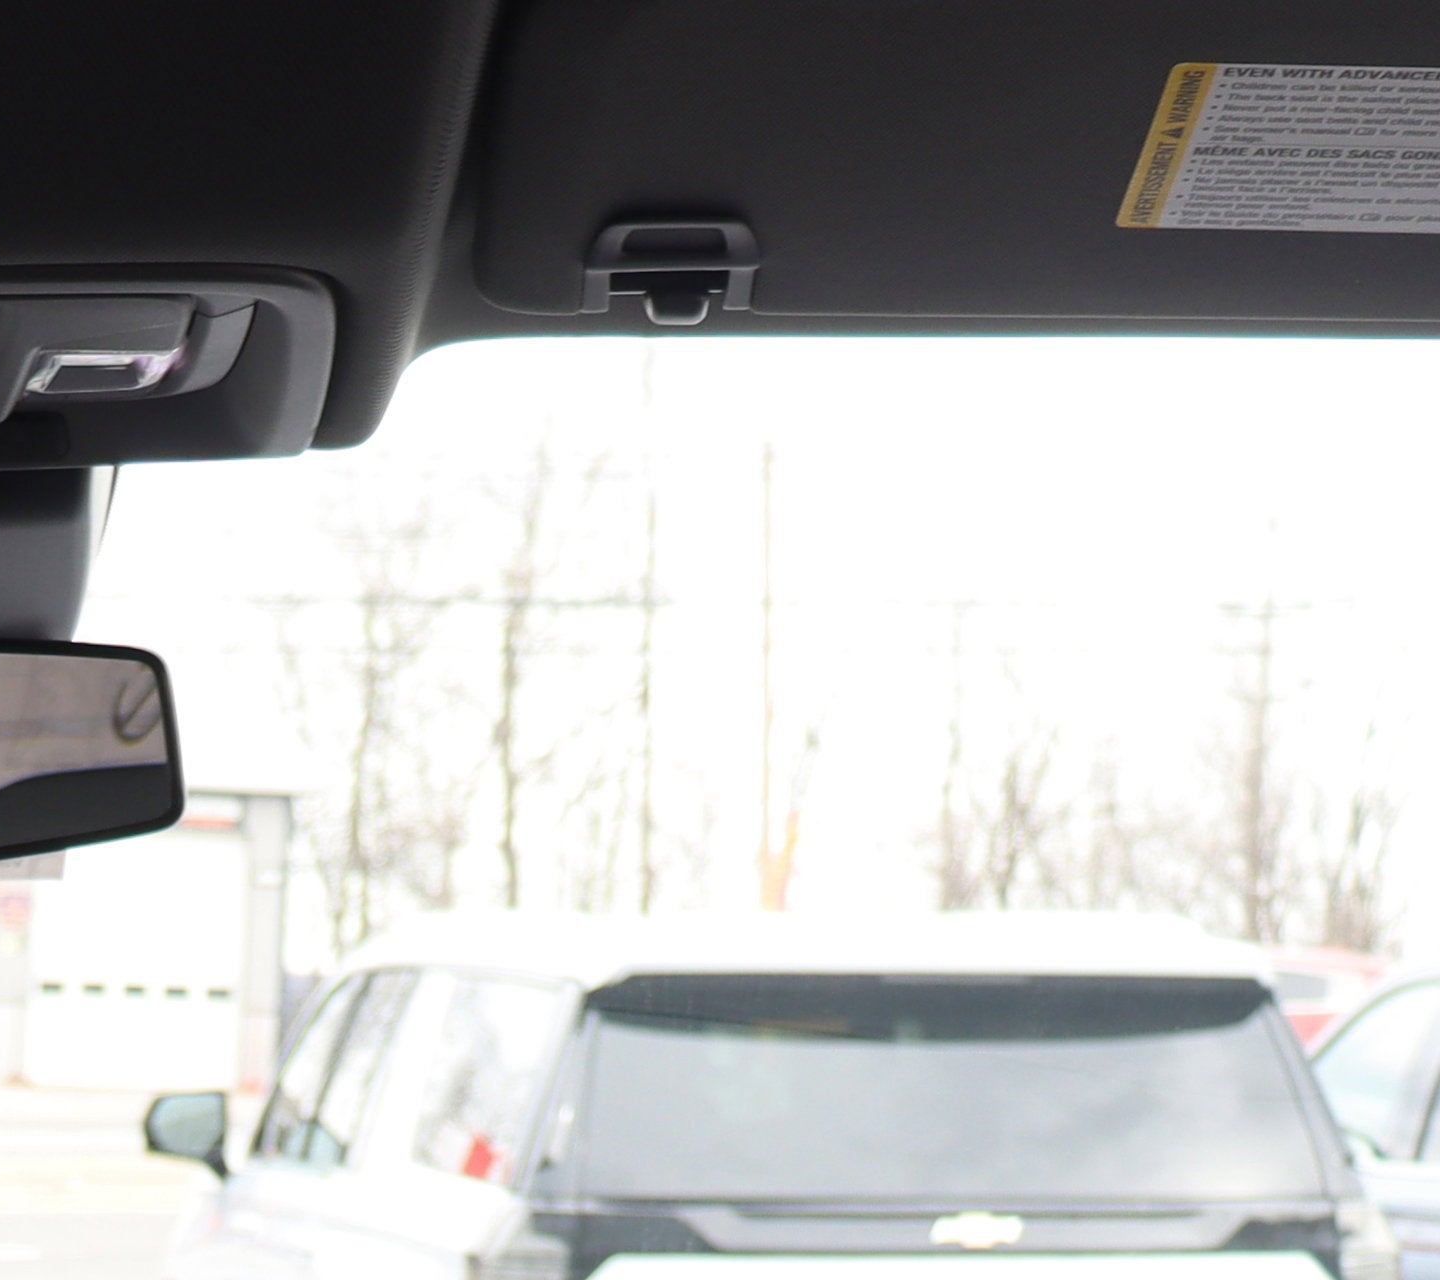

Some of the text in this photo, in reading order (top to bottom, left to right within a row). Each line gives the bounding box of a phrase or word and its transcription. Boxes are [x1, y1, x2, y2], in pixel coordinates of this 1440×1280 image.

[1223, 67, 1278, 78] EVEN
[1282, 68, 1334, 79] WITH
[1167, 70, 1205, 124] WARNING
[1253, 148, 1303, 158] AVEC
[1306, 149, 1342, 159] DES
[1345, 150, 1395, 161] SACS
[1130, 142, 1178, 223] AVERTISSEMENT
